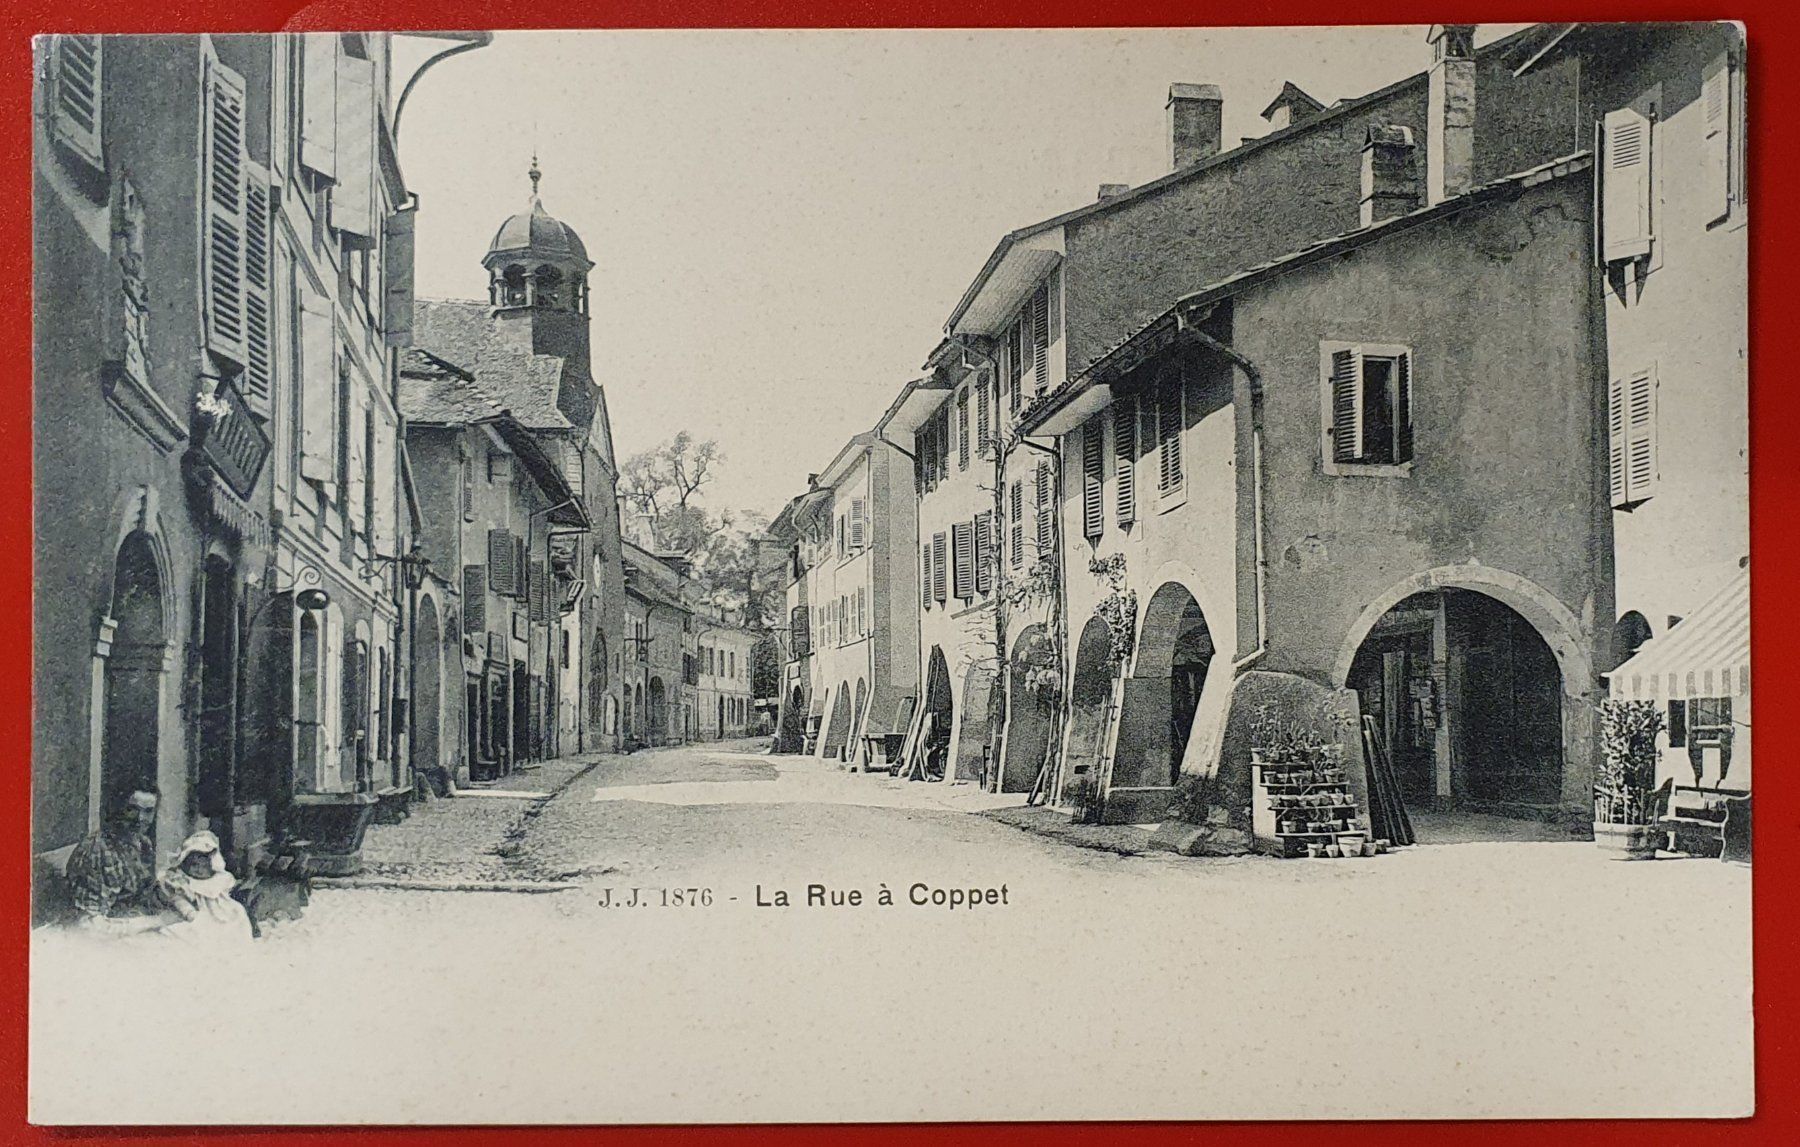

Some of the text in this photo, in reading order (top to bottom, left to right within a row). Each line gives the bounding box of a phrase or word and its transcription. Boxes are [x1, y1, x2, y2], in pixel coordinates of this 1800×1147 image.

[659, 887, 713, 908] 1876
[756, 884, 790, 907] La
[807, 884, 862, 907] Rue
[878, 883, 894, 906] à
[909, 882, 1009, 910] Coppet
